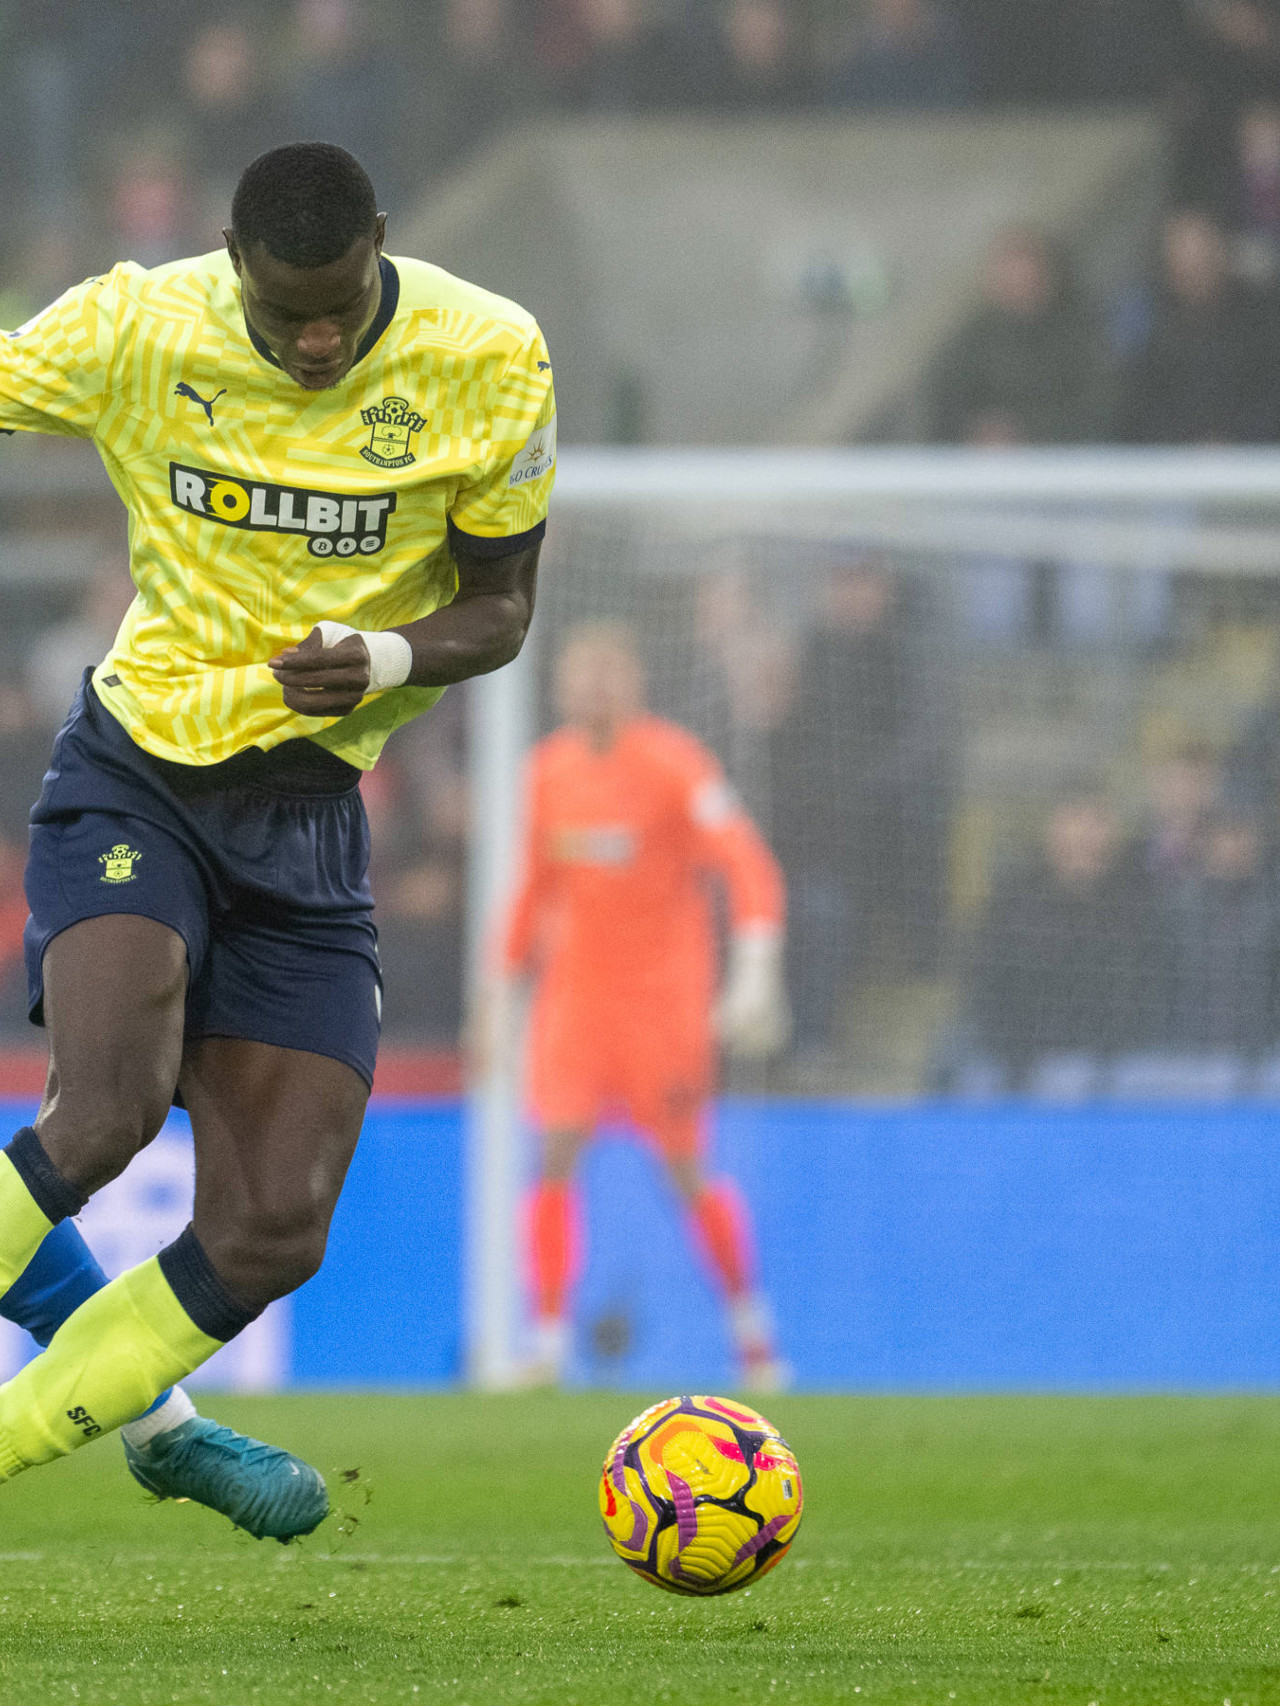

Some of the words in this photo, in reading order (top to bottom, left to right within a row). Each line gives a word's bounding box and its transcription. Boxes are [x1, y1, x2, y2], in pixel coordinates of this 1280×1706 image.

[362, 449, 404, 467] SOUTHAMPTON
[175, 469, 389, 533] ROLLBIT
[67, 1406, 102, 1437] SFC
